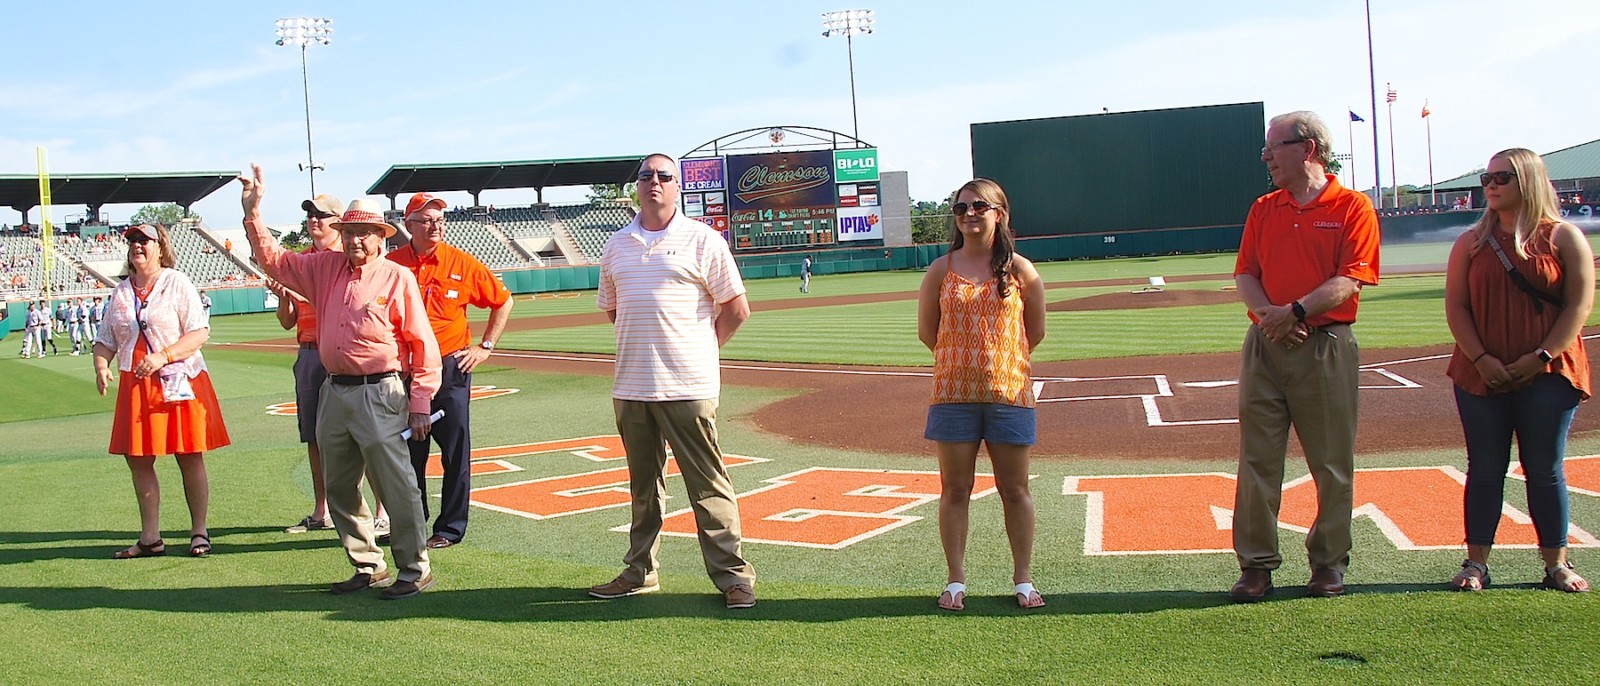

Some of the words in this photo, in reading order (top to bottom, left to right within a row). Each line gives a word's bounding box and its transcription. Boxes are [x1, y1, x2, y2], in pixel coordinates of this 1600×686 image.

[685, 167, 720, 182] BEST
[737, 165, 829, 192] Clemson
[685, 181, 697, 190] ICE
[696, 180, 722, 189] CREAM
[758, 208, 774, 221] 14
[840, 215, 872, 234] IPTAY
[1312, 220, 1342, 228] CLEMSON
